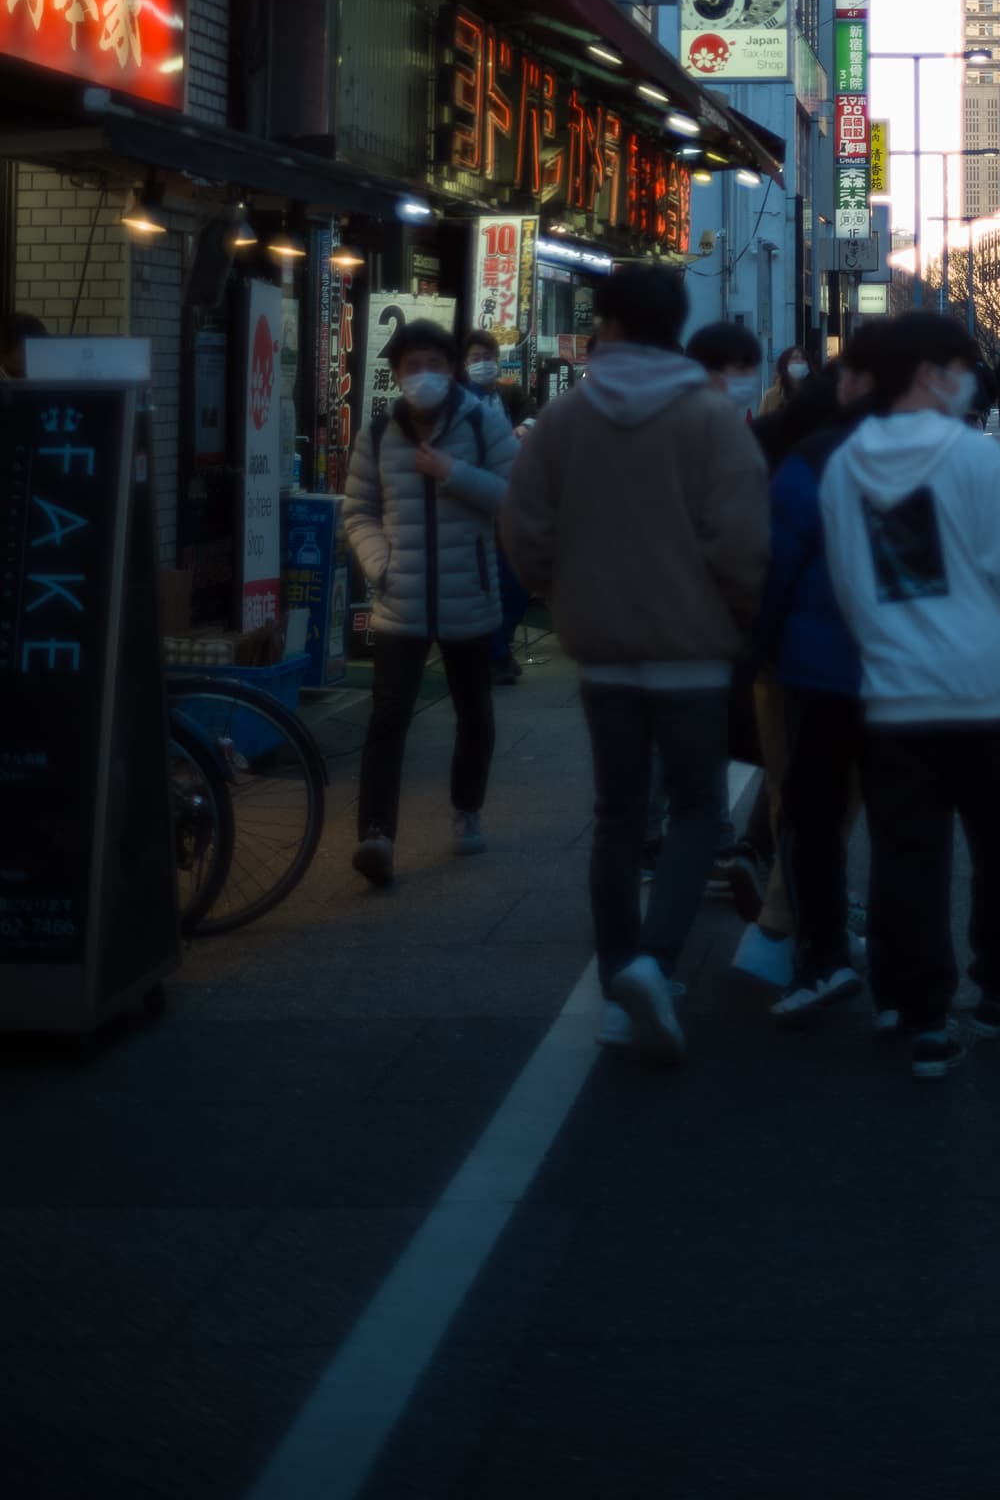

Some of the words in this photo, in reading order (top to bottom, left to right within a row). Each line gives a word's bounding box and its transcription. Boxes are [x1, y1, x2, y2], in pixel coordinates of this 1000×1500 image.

[746, 35, 783, 47] Japan.
[741, 48, 783, 59] Tax-free
[757, 59, 783, 71] Shop
[839, 96, 866, 106] スマホ
[843, 106, 862, 115] PC
[848, 228, 860, 238] 1F
[483, 224, 517, 257] 10
[499, 257, 517, 326] ポイント
[21, 443, 96, 673] FAKE
